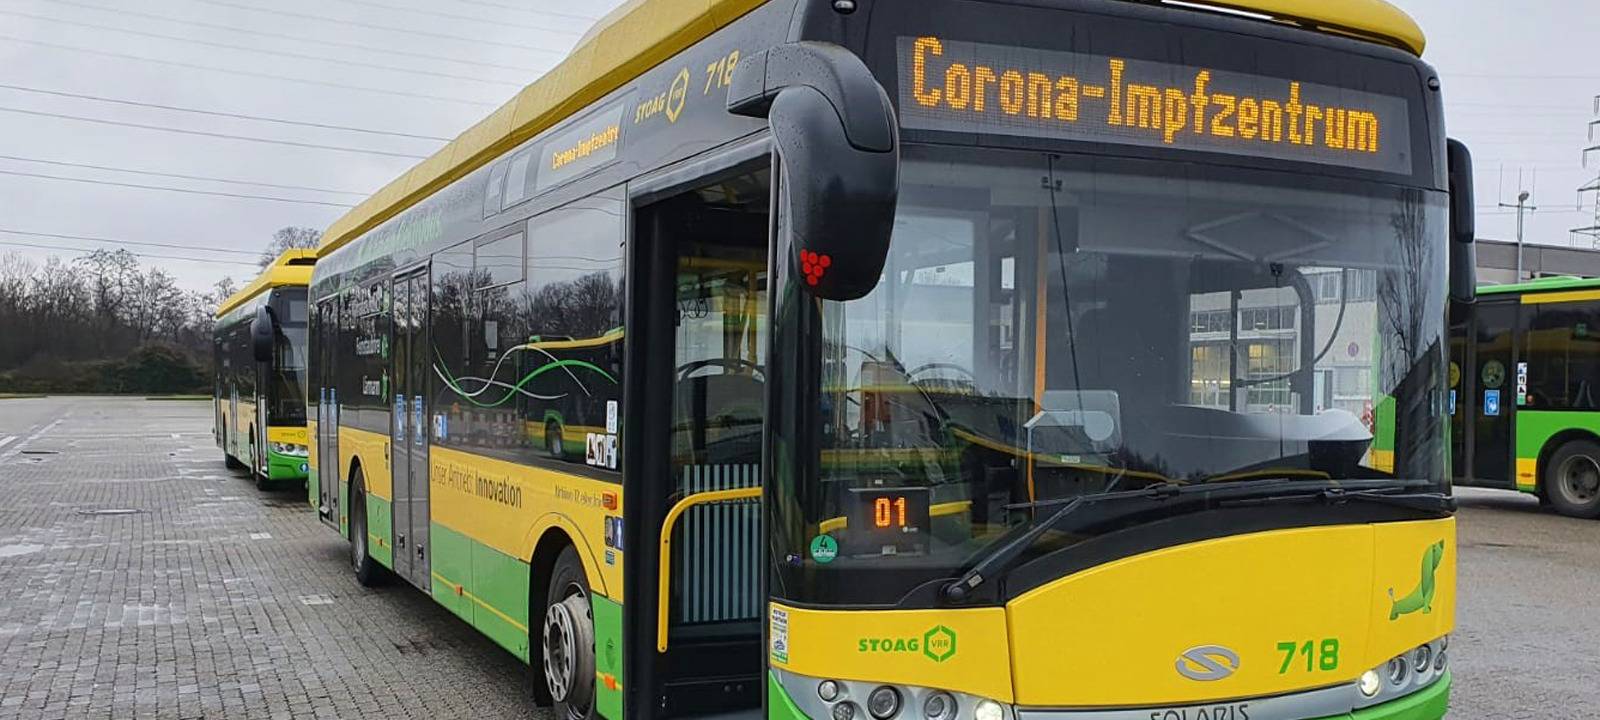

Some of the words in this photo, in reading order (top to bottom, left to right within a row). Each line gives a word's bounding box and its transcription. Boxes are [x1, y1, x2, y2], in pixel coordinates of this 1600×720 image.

[704, 50, 739, 95] 718
[634, 93, 665, 124] STOAG
[912, 36, 1379, 153] Corona-Impfzentrum
[475, 469, 522, 509] Innovation
[874, 496, 906, 528] 01
[819, 535, 829, 549] 4
[858, 638, 919, 653] STOAG
[1277, 638, 1339, 675] 718
